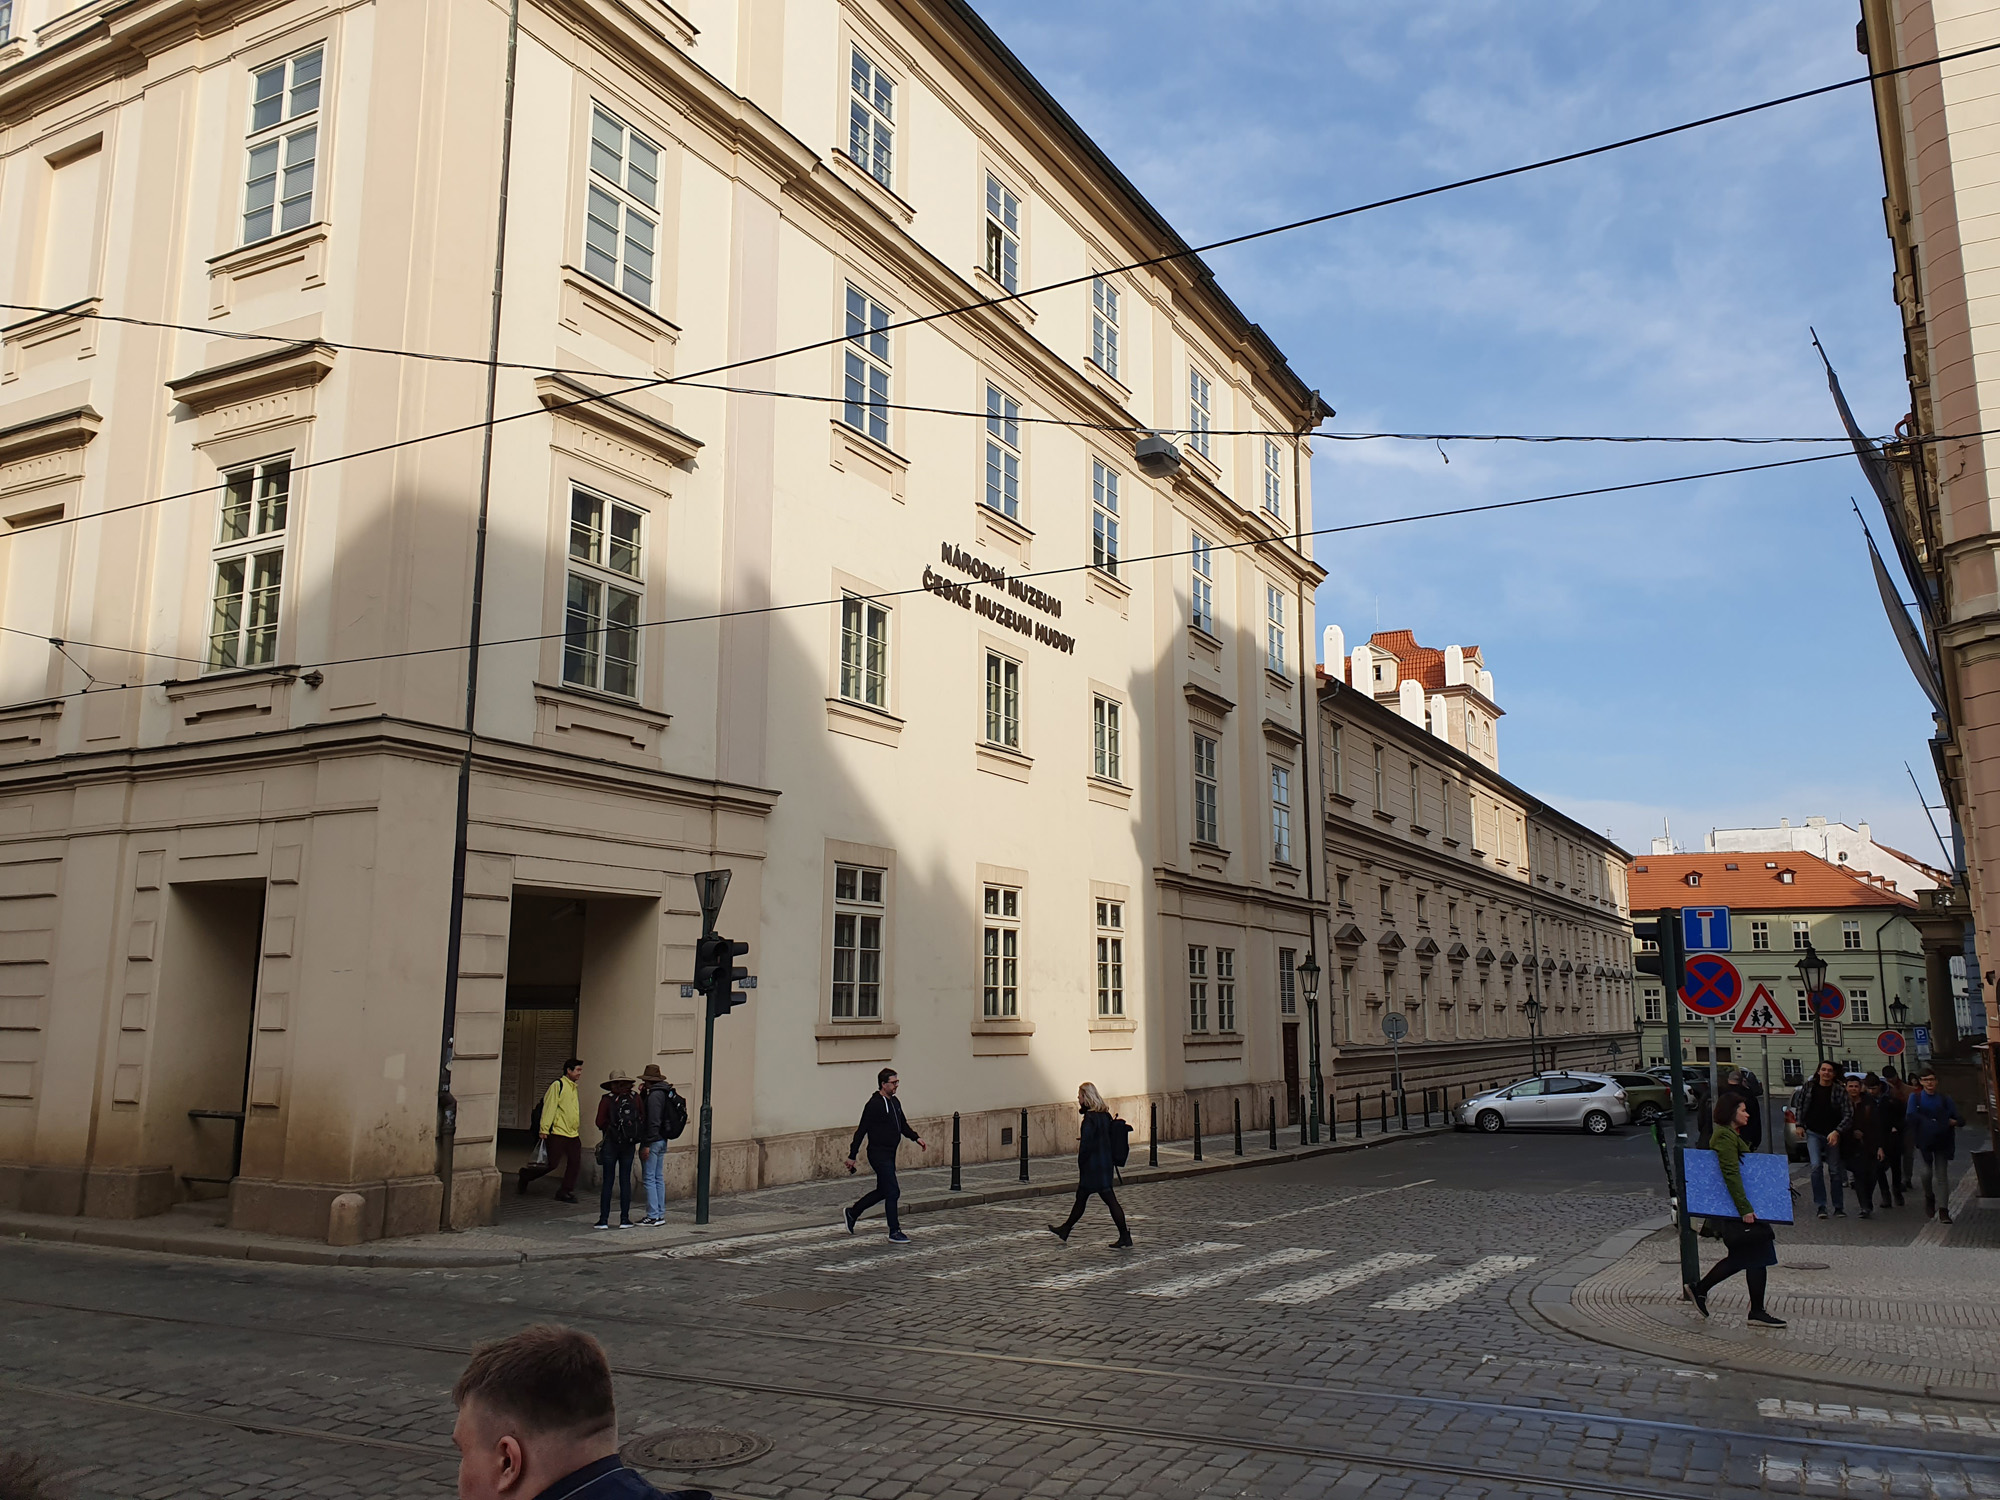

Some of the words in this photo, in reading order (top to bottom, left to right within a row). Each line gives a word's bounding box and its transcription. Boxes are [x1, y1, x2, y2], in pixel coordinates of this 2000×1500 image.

[922, 563, 972, 611] ČESKÉ
[974, 593, 1033, 638] MUZEUM
[1034, 621, 1076, 655] HUDBY
[941, 541, 1005, 591] NÁRODNÍ
[1008, 576, 1062, 619] MUZEUM
